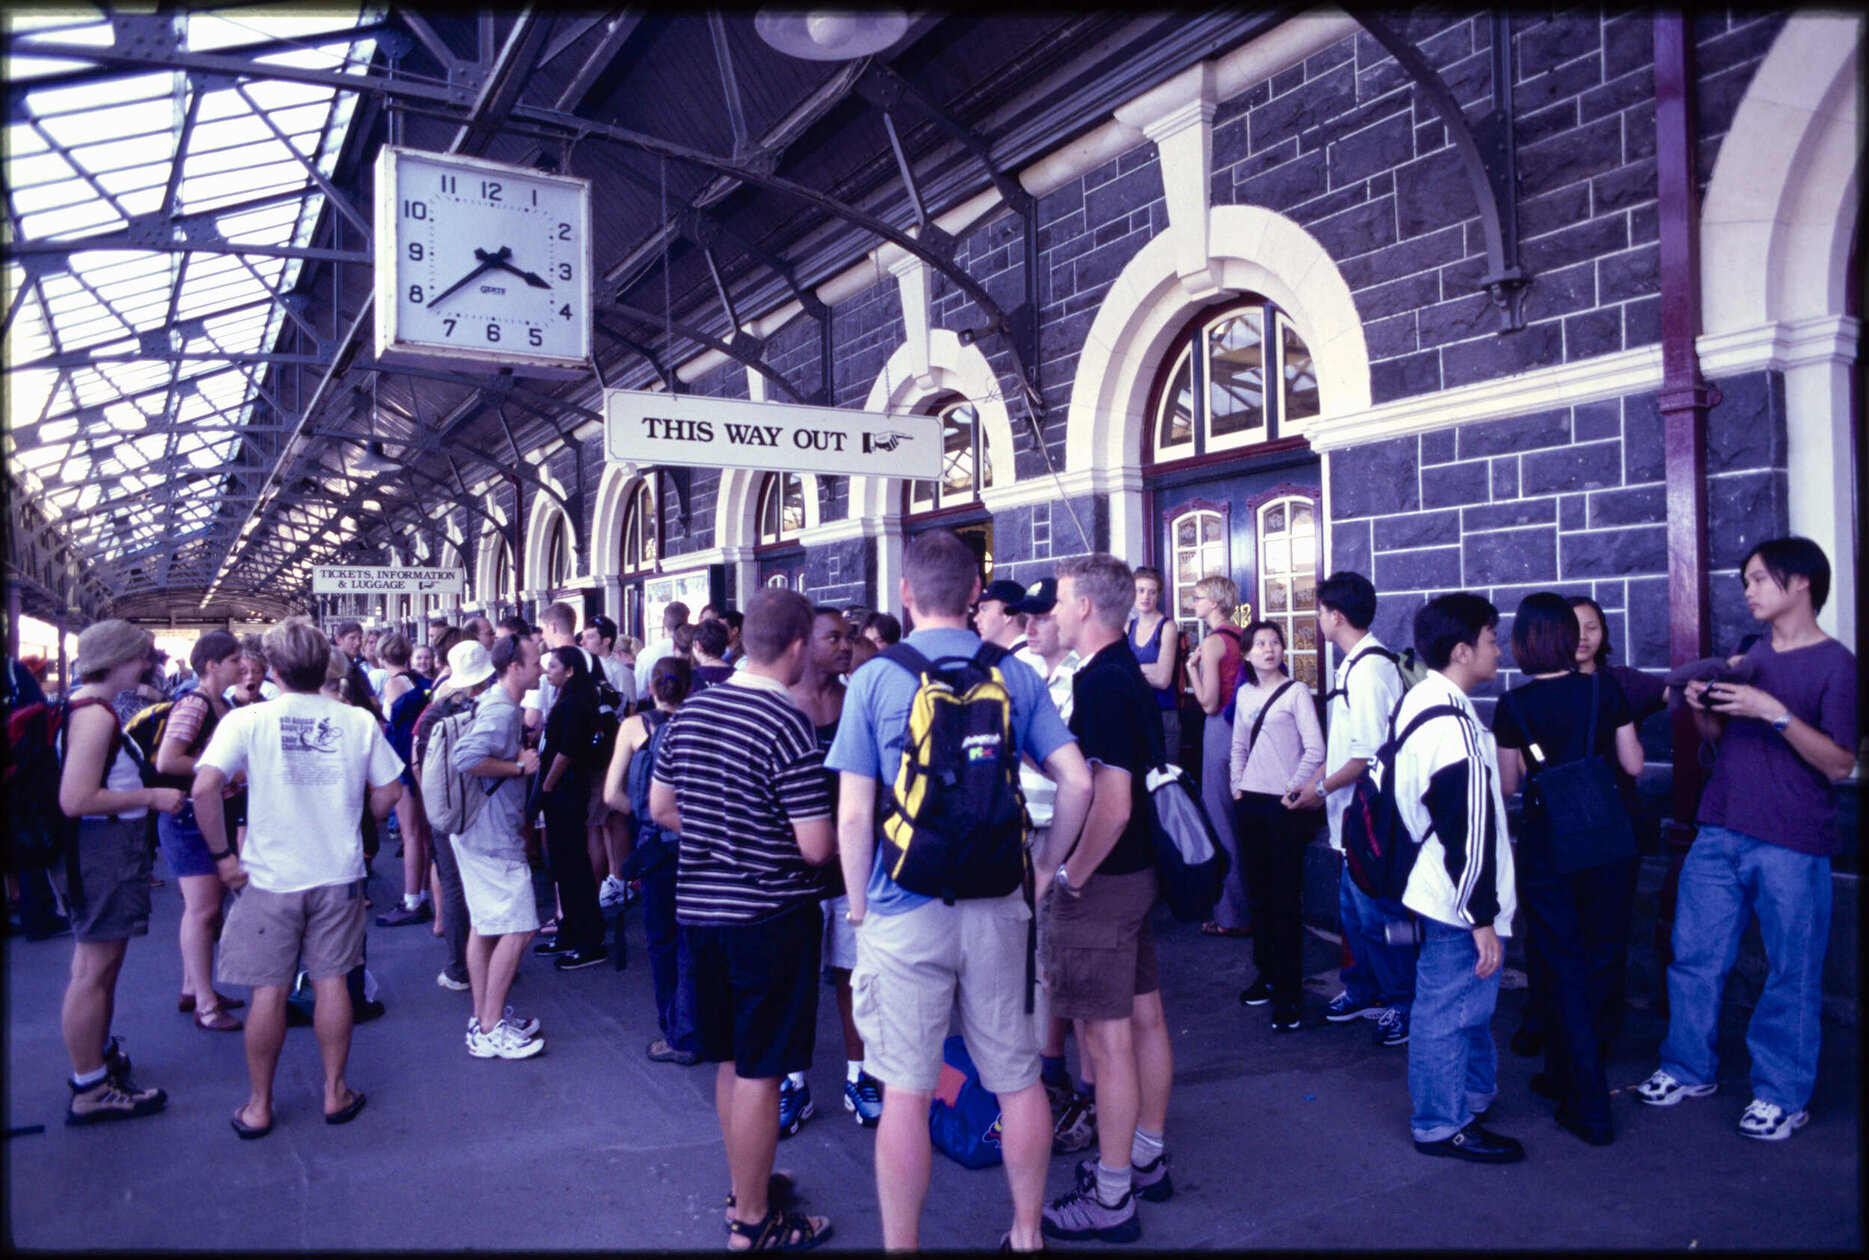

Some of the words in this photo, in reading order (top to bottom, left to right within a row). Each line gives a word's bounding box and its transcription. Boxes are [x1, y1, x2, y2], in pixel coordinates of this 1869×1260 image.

[441, 174, 456, 195] 11
[481, 181, 503, 202] 12
[404, 199, 427, 221] 10
[558, 222, 572, 241] 2
[408, 242, 424, 262] 9
[558, 262, 572, 281] 3
[408, 284, 424, 304] 8
[559, 303, 573, 321] 4
[443, 318, 457, 337] 7
[486, 323, 501, 343] 6
[529, 327, 543, 347] 5
[641, 417, 714, 442] THIS
[724, 423, 783, 446] WAY
[793, 428, 848, 451] OUT
[320, 569, 374, 579] TICKETS,
[377, 570, 456, 580] INFORMATION
[337, 580, 347, 589] &
[351, 580, 406, 589] LUGGAGE
